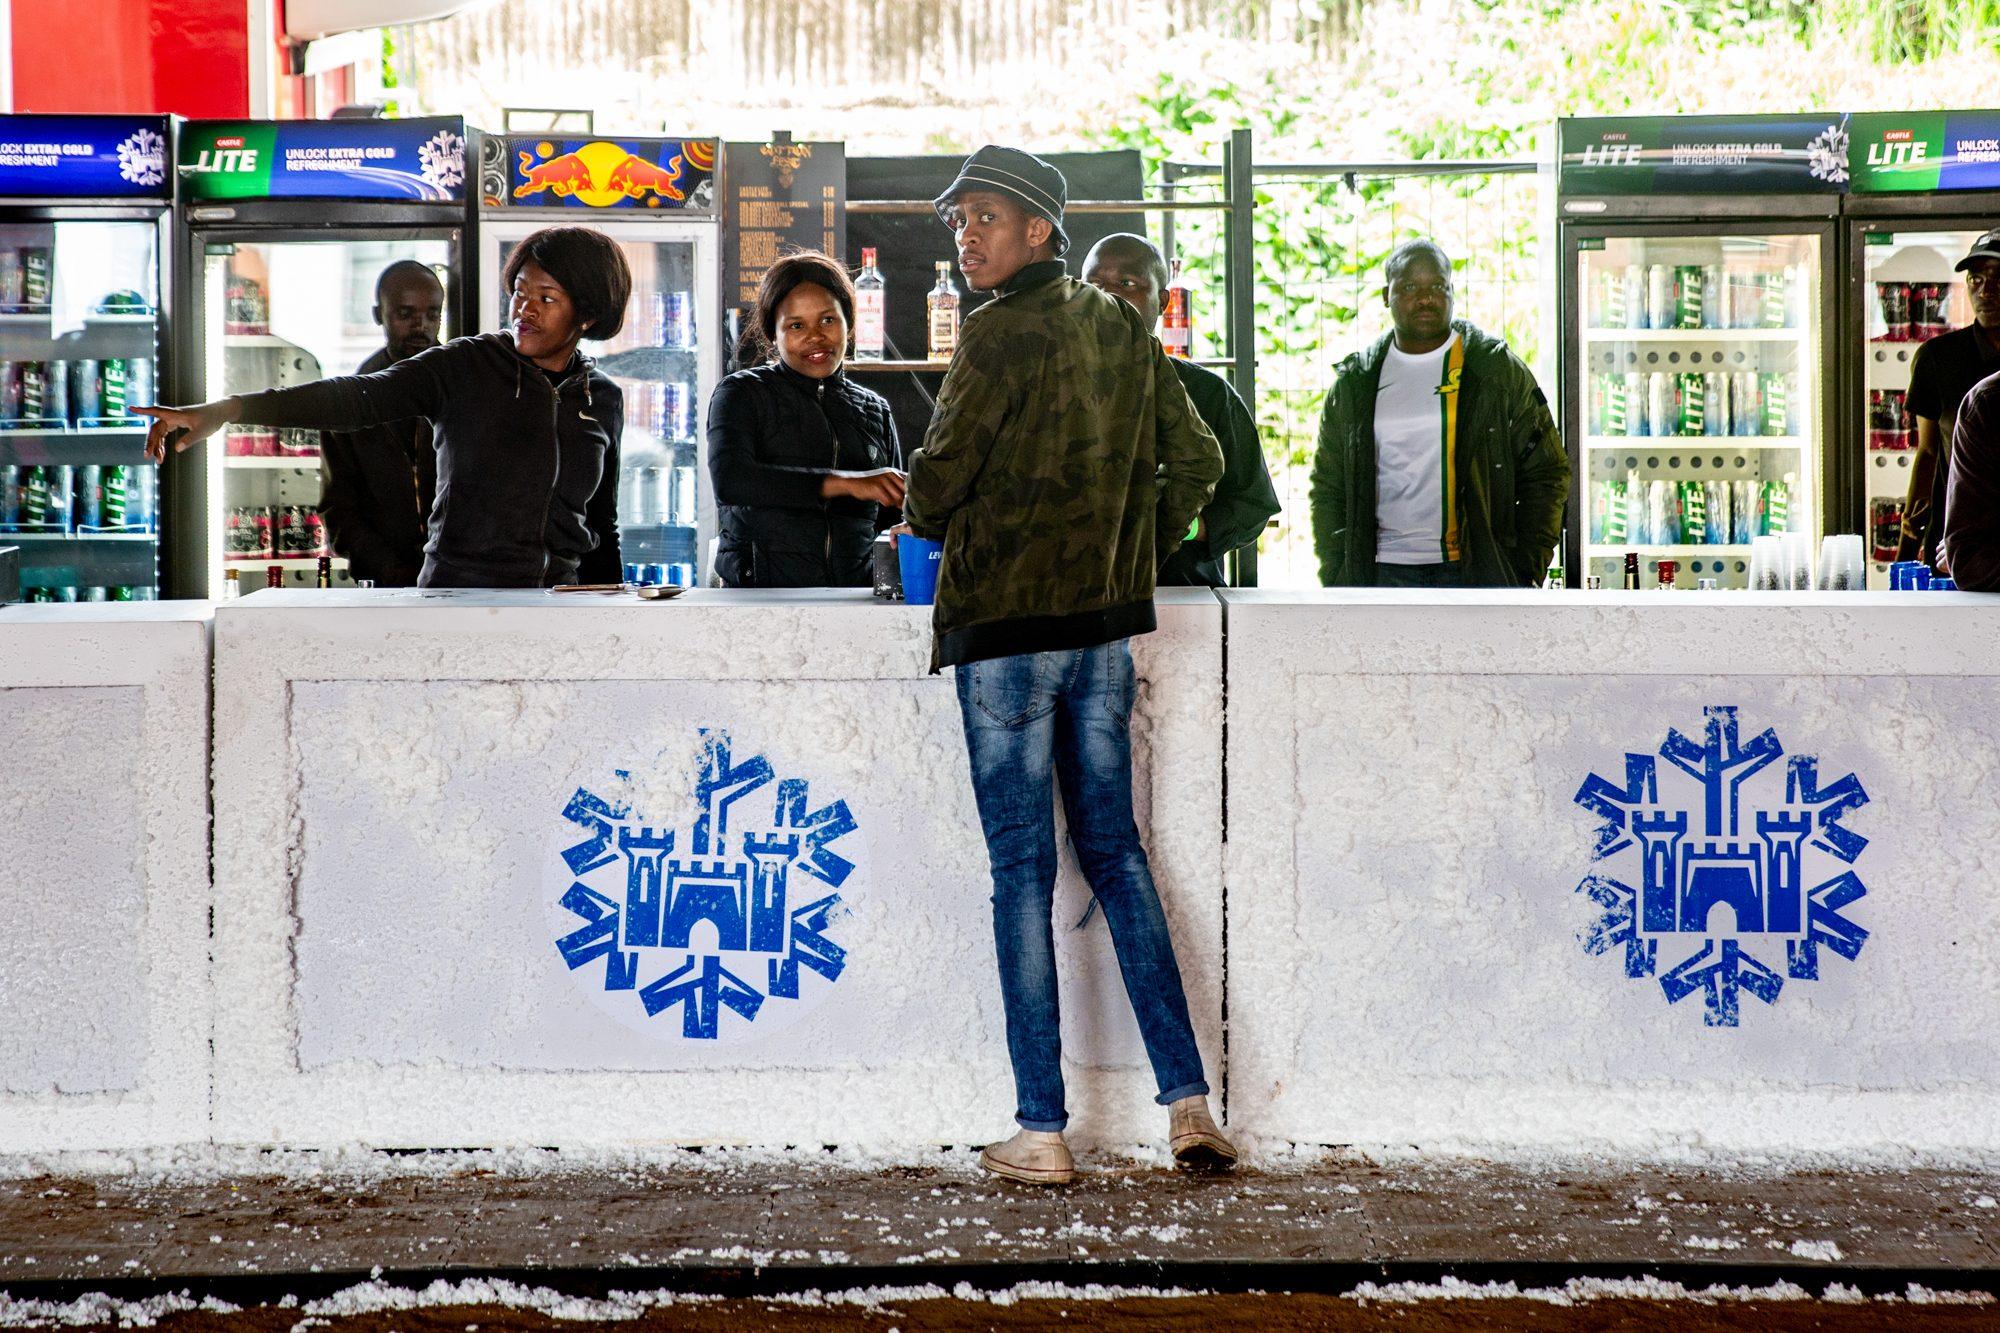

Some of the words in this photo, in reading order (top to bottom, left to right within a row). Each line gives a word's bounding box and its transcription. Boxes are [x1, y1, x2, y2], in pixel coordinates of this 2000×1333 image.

[0, 143, 24, 155] OCK
[24, 143, 62, 155] EXTRA
[62, 144, 94, 155] COLD
[217, 139, 242, 147] CASTLE
[286, 148, 327, 159] UNLOCK
[328, 148, 364, 159] EXTRA
[365, 148, 395, 159] COLD
[1582, 144, 1643, 166] LITE
[1603, 133, 1627, 141] CASTLE
[1672, 144, 1713, 154] UNLOCK
[1715, 143, 1752, 154] EXTRA
[1753, 143, 1782, 153] COLD
[1867, 142, 1927, 165] LITE
[1886, 131, 1911, 140] CASTLE
[1957, 139, 1999, 151] UNLOCK
[198, 150, 258, 172] LITE
[286, 159, 361, 171] REFRESHMENT
[1672, 154, 1748, 165] REFRESHMENT
[28, 256, 46, 304] LITE
[1608, 275, 1626, 324] LITE
[1684, 272, 1701, 328] LITE
[1766, 273, 1784, 323] LITE
[24, 372, 43, 419] LITE
[105, 367, 126, 418] LITE
[1608, 382, 1626, 430] LITE
[1685, 378, 1704, 430] LITE
[1767, 380, 1787, 428] LITE
[28, 478, 46, 525] LITE
[107, 477, 127, 526] LITE
[1609, 489, 1628, 538] LITE
[1687, 489, 1706, 537] LITE
[1769, 489, 1788, 536] LITE
